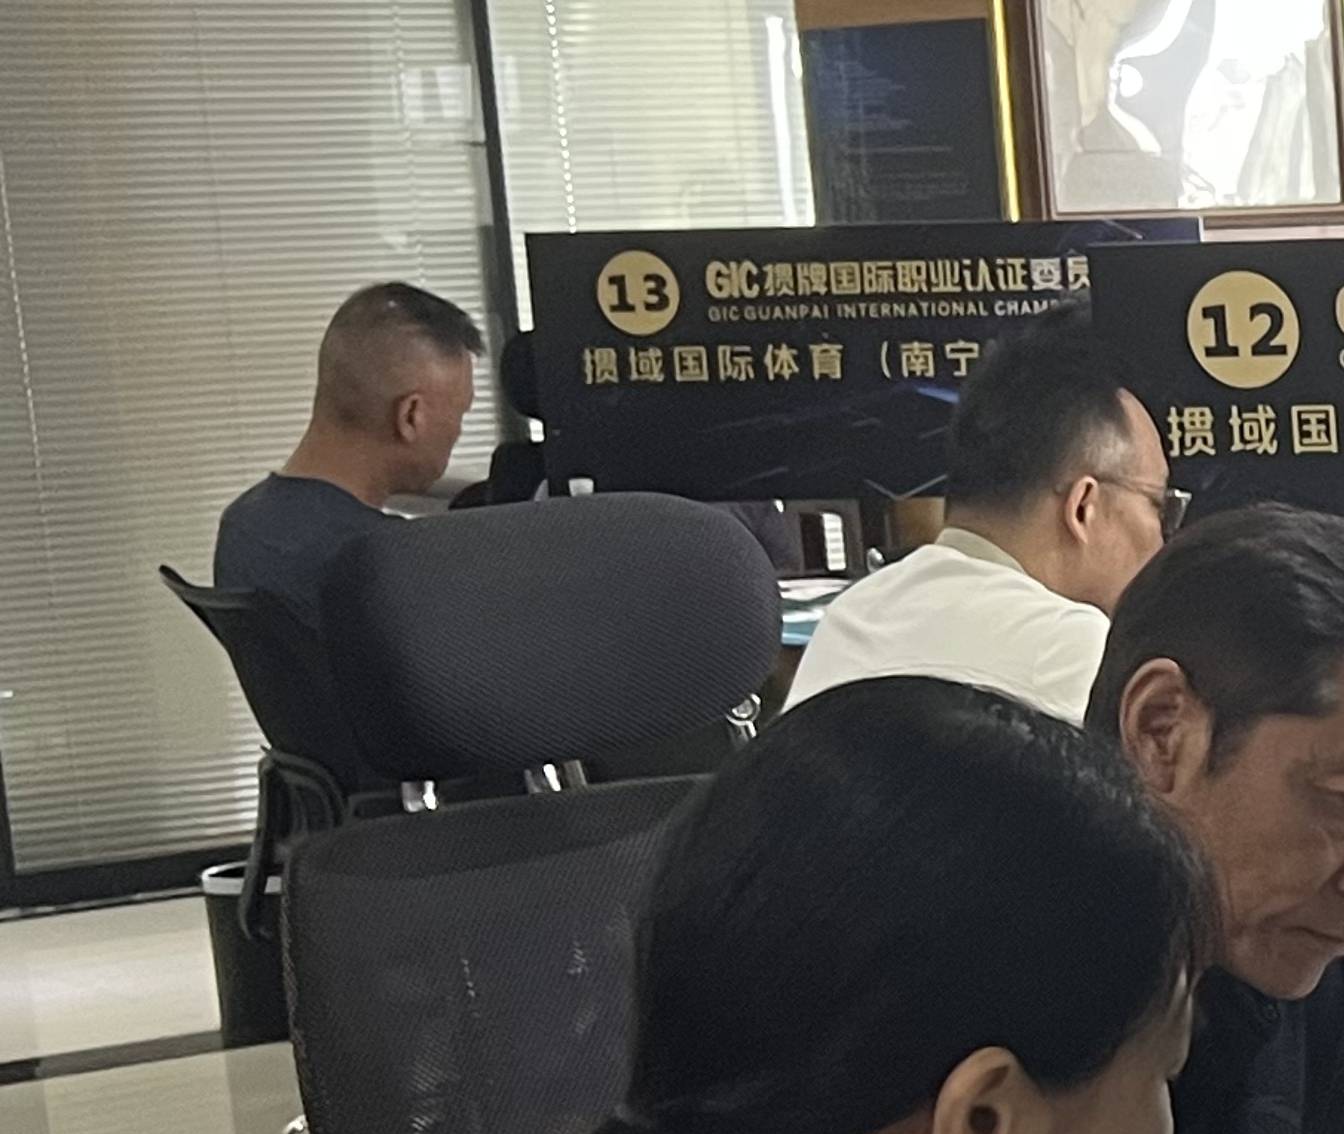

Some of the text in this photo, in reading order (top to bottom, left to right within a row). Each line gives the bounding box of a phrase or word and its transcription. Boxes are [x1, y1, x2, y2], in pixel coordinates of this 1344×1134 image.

[608, 273, 670, 313] 13
[708, 304, 740, 322] GIC
[743, 303, 829, 321] GUANPAI
[837, 300, 988, 319] INTERNATIONAL
[1202, 302, 1288, 358] 12
